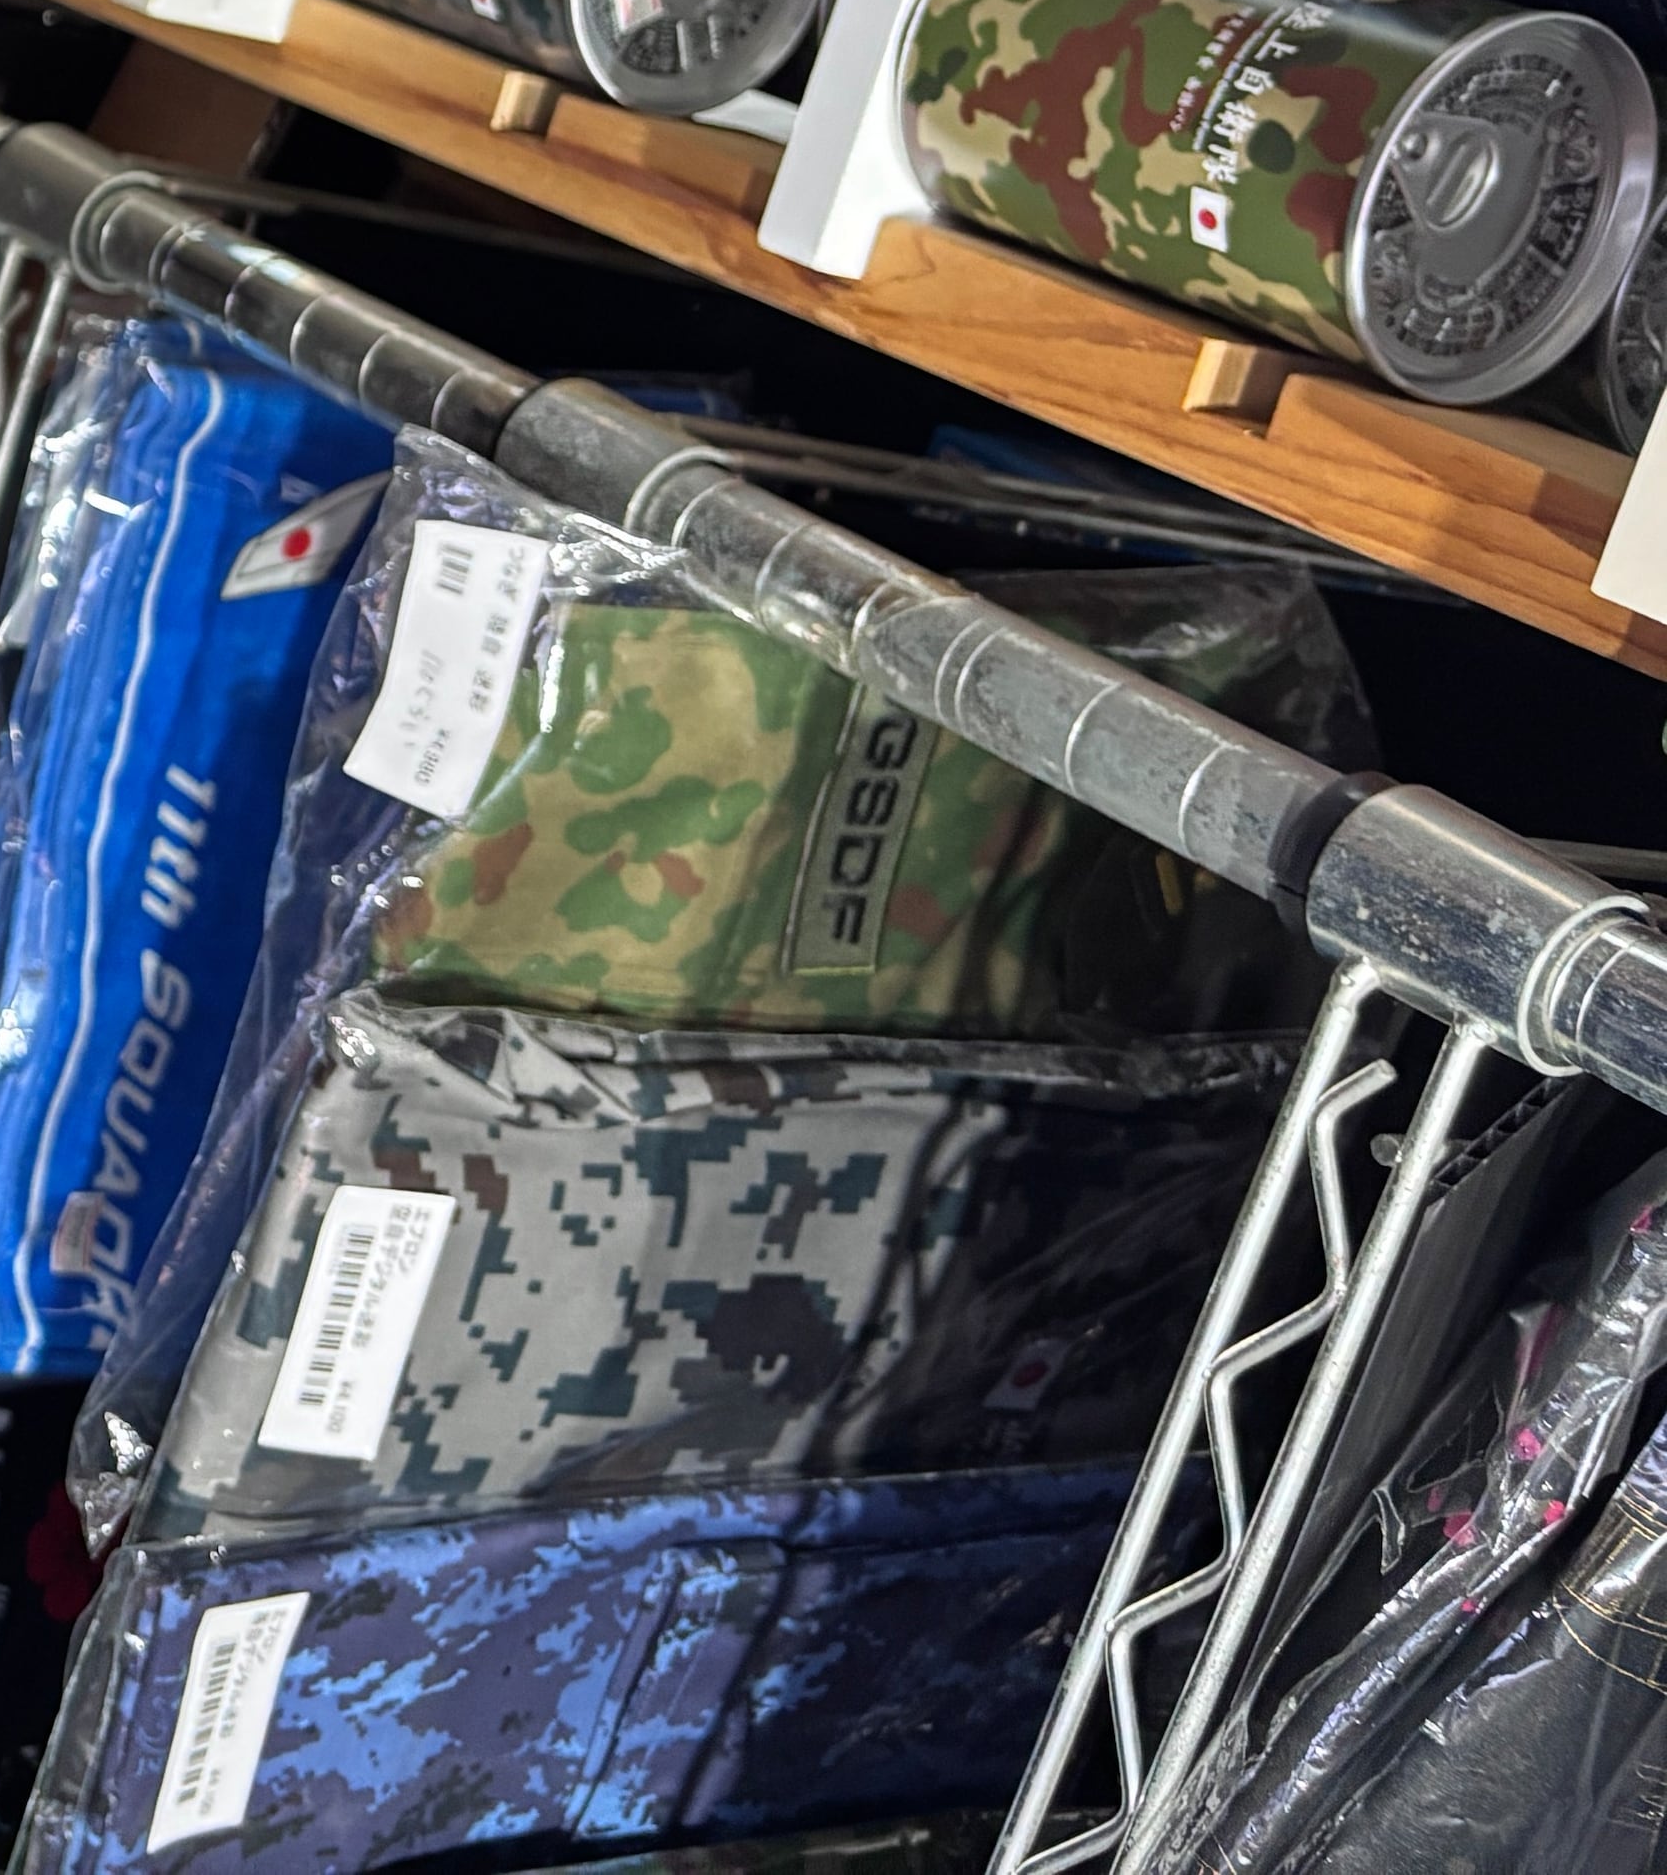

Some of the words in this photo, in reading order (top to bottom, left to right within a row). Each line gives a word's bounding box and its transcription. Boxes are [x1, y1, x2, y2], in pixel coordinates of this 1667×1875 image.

[1200, 1, 1333, 185] 陸上自衛隊
[137, 763, 218, 930] 11th
[821, 695, 920, 945] GSDF
